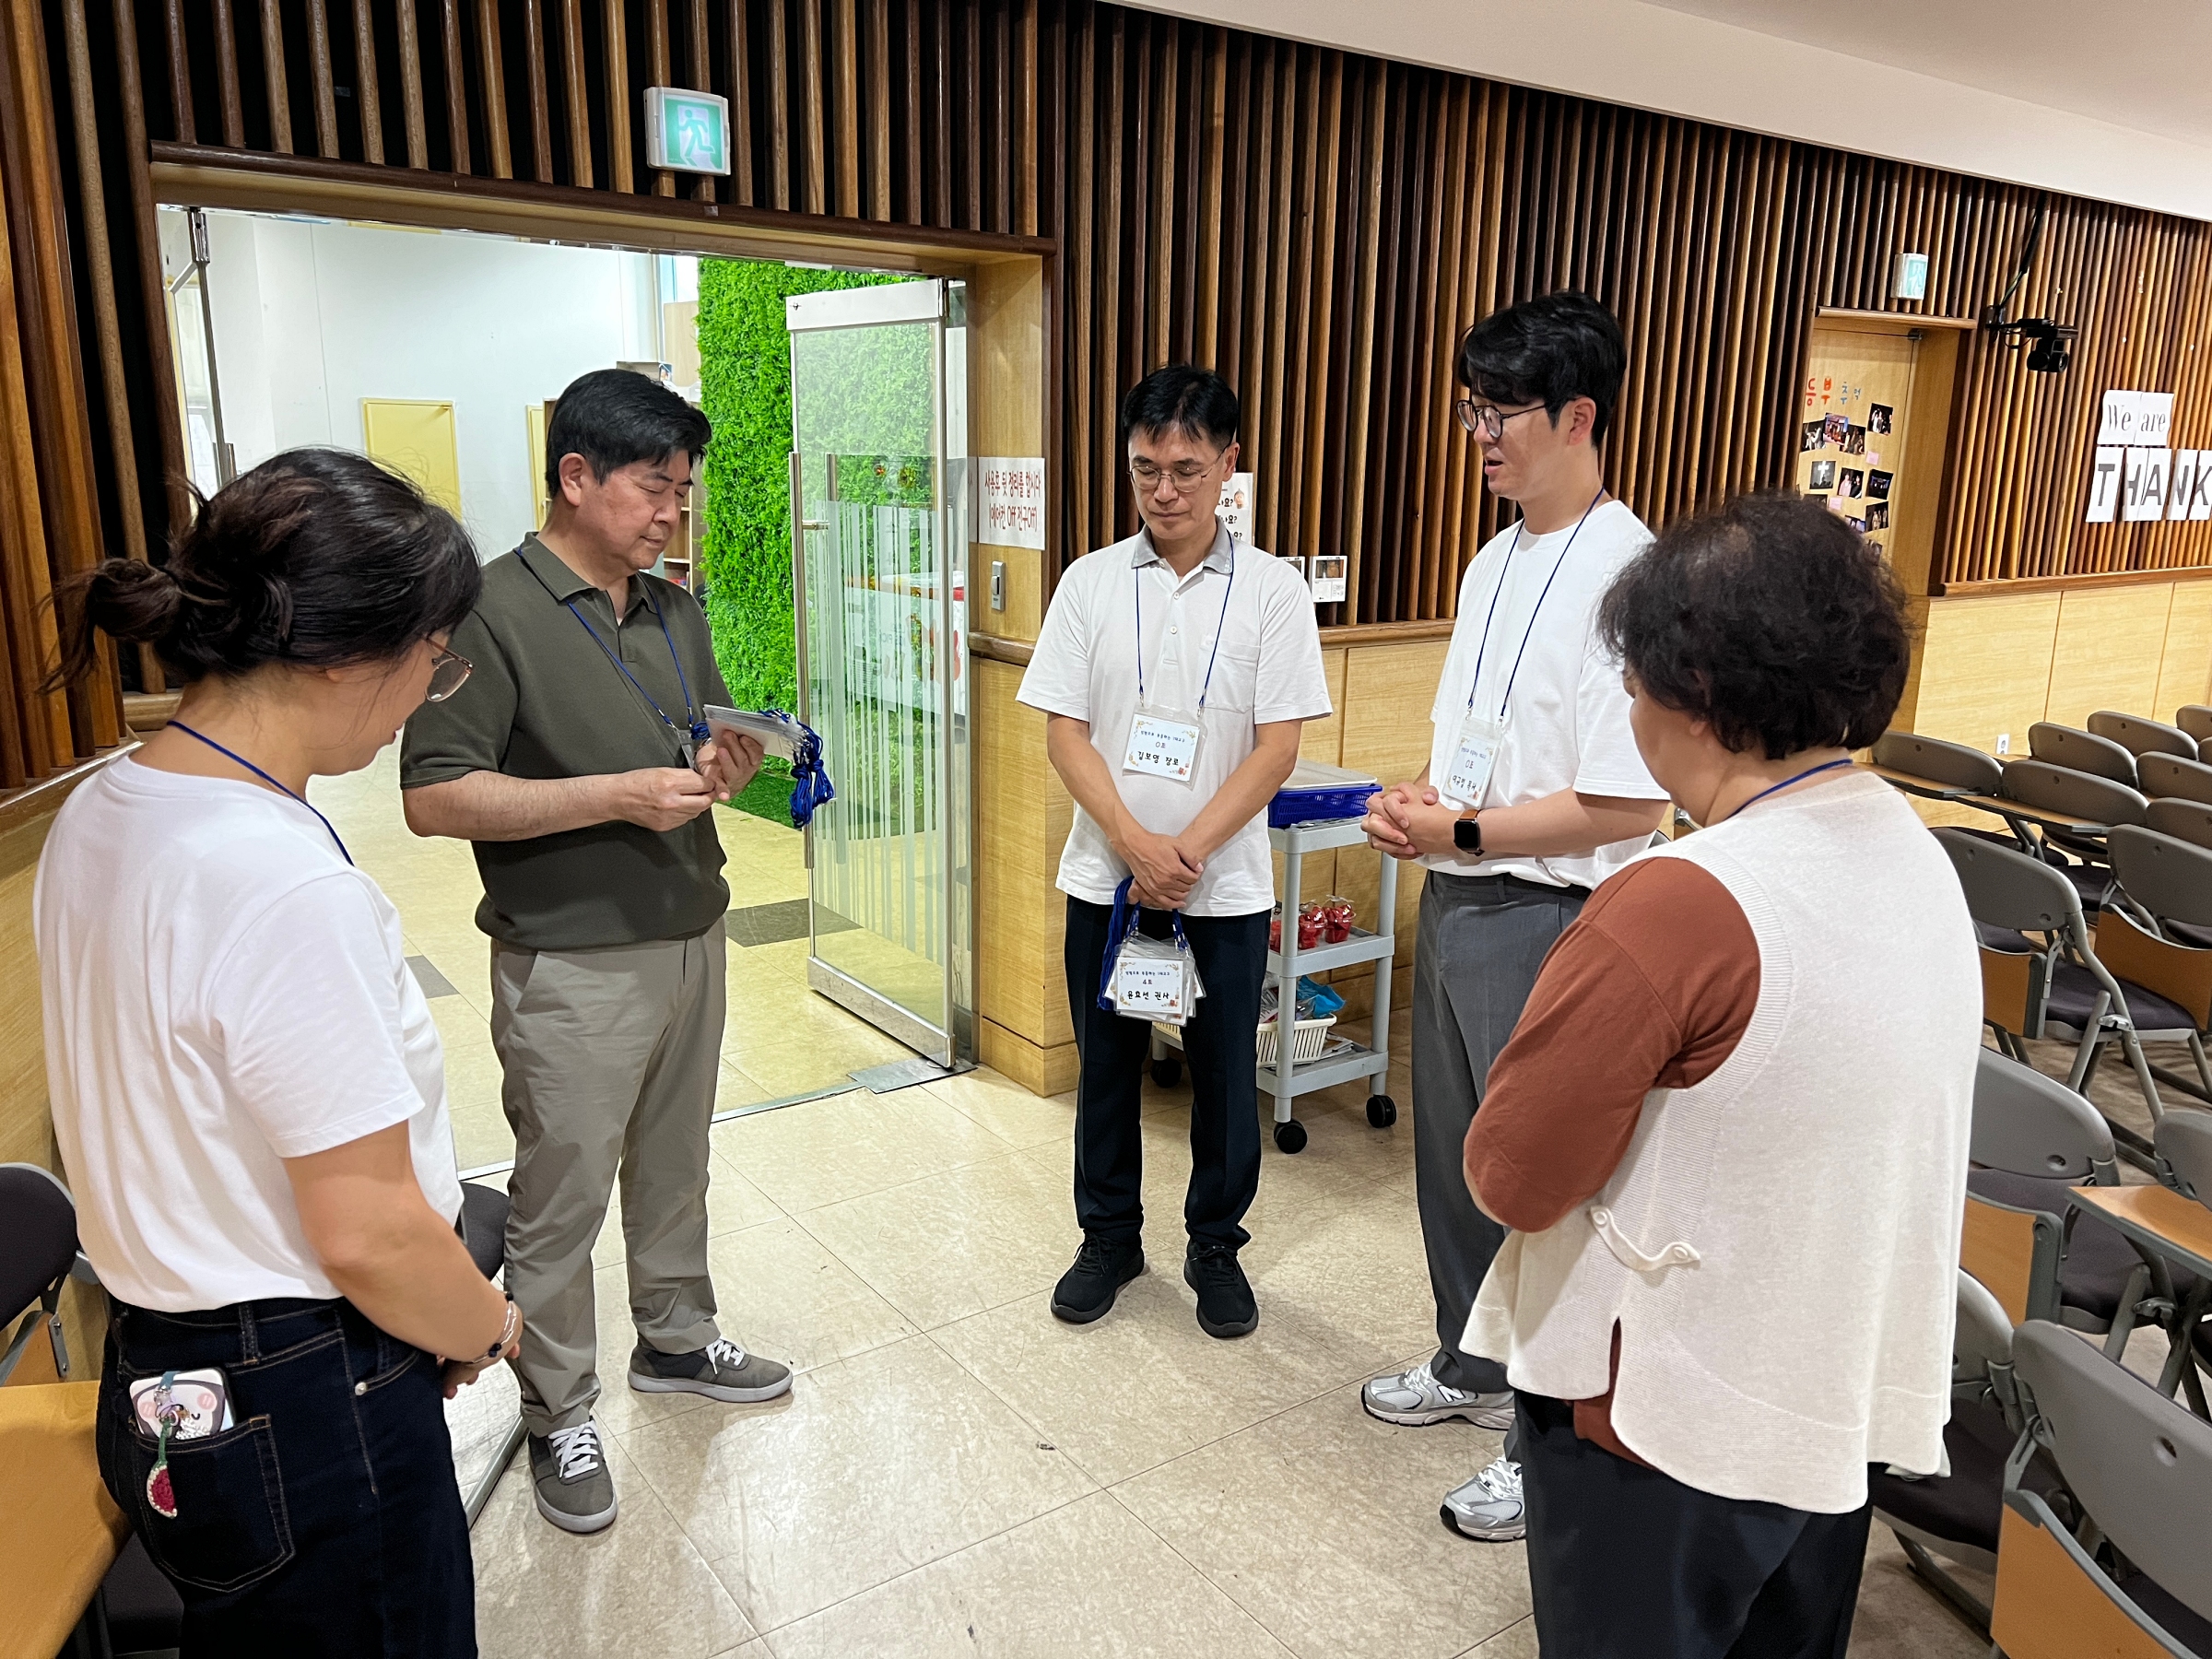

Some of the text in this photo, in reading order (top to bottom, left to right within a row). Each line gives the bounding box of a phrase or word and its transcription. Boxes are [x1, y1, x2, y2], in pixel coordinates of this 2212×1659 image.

[2108, 404, 2166, 432] We are
[984, 470, 1001, 497] 사용후
[1008, 470, 1025, 498] 정리를
[1025, 471, 1041, 499] 합시다
[1165, 756, 1180, 766] 장로
[1154, 991, 1170, 1001] 권사
